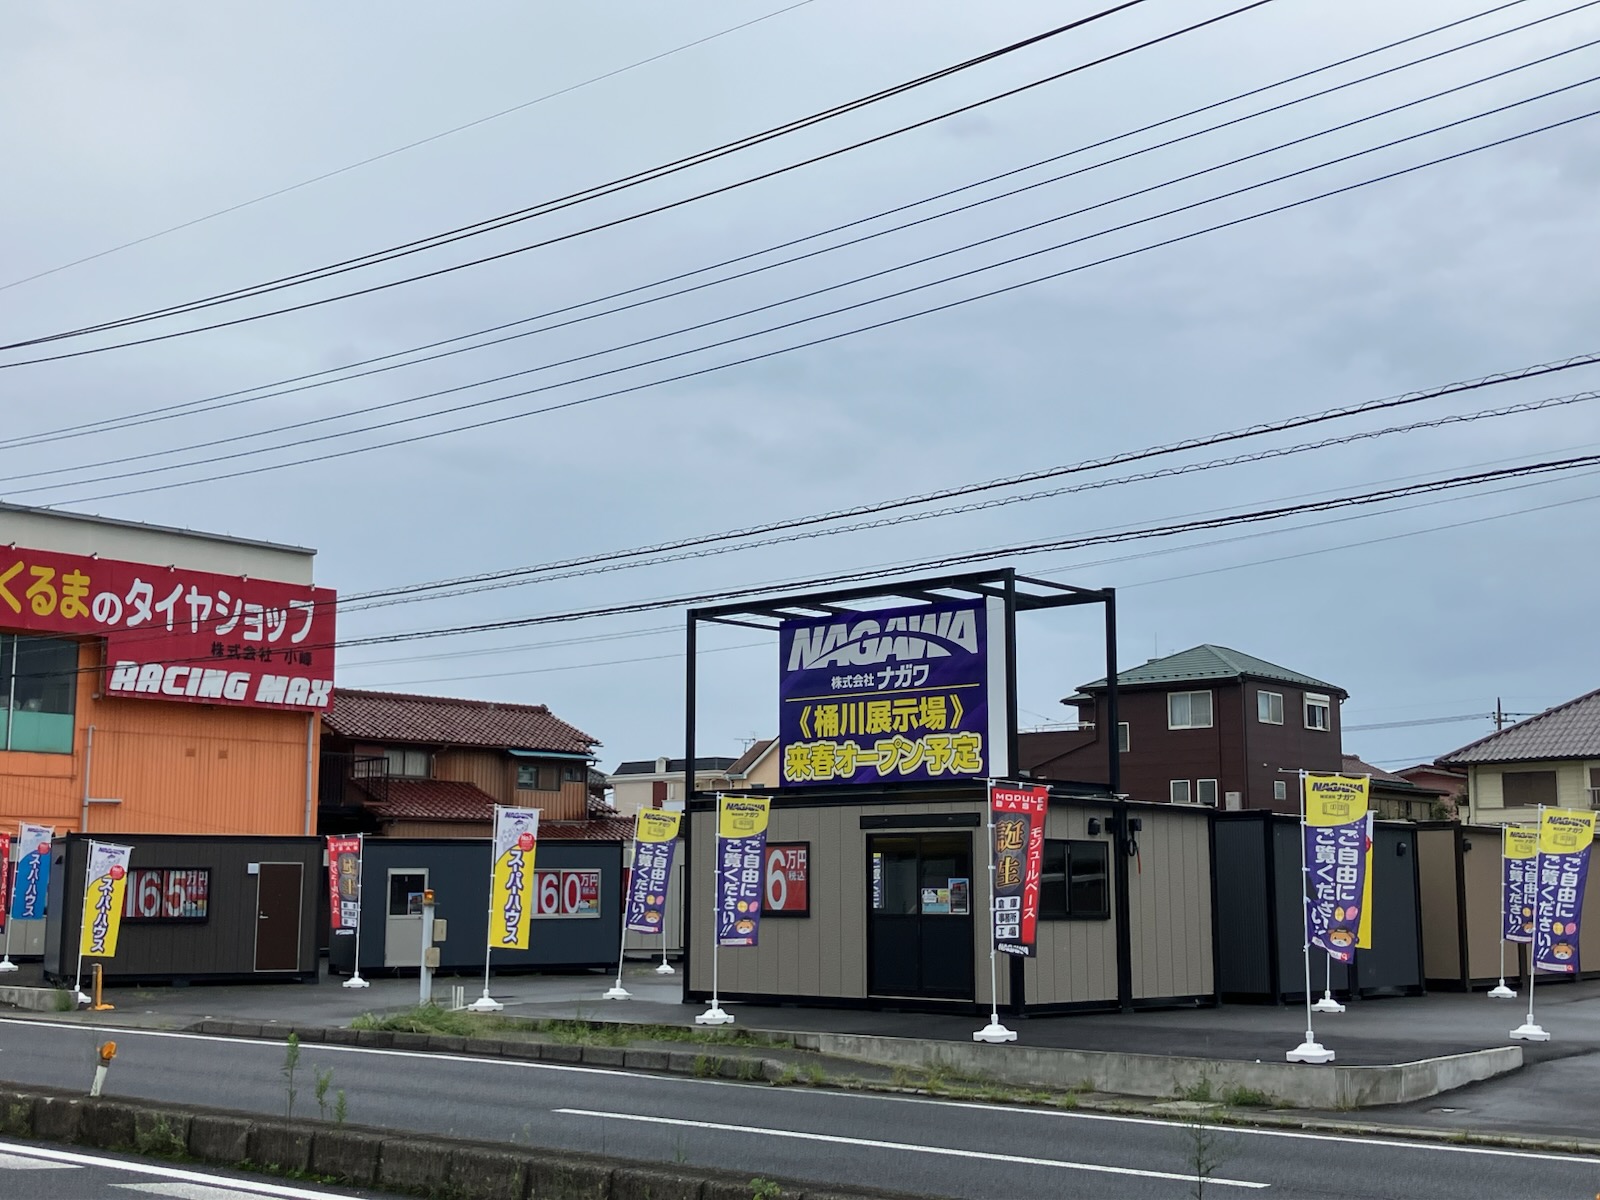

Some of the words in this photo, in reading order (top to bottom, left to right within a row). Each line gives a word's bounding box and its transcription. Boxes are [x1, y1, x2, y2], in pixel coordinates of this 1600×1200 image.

[787, 609, 979, 672] NAGAWA
[110, 660, 252, 701] RACING
[255, 673, 333, 708] MAX
[831, 673, 875, 690] 株式会社
[876, 664, 930, 690] ナガワ
[784, 732, 983, 782] 来春オープン予定
[725, 802, 766, 812] NAGAWA
[995, 792, 1045, 804] MODULE
[995, 800, 1044, 812] BASE
[1312, 781, 1364, 793] NAGAWA
[1547, 815, 1592, 828] NAGAWA
[649, 844, 669, 892] ご自由に
[740, 839, 761, 897] ご自由に
[995, 819, 1025, 888] 誕生
[1023, 826, 1042, 920] モジュールベース
[1336, 828, 1360, 901] ご自由に
[22, 853, 41, 917] スーパーハウス
[126, 870, 187, 917] 165
[503, 850, 525, 945] スーパーハウス
[1555, 856, 1582, 918] ご自由に
[91, 877, 114, 953] スーパーハウス
